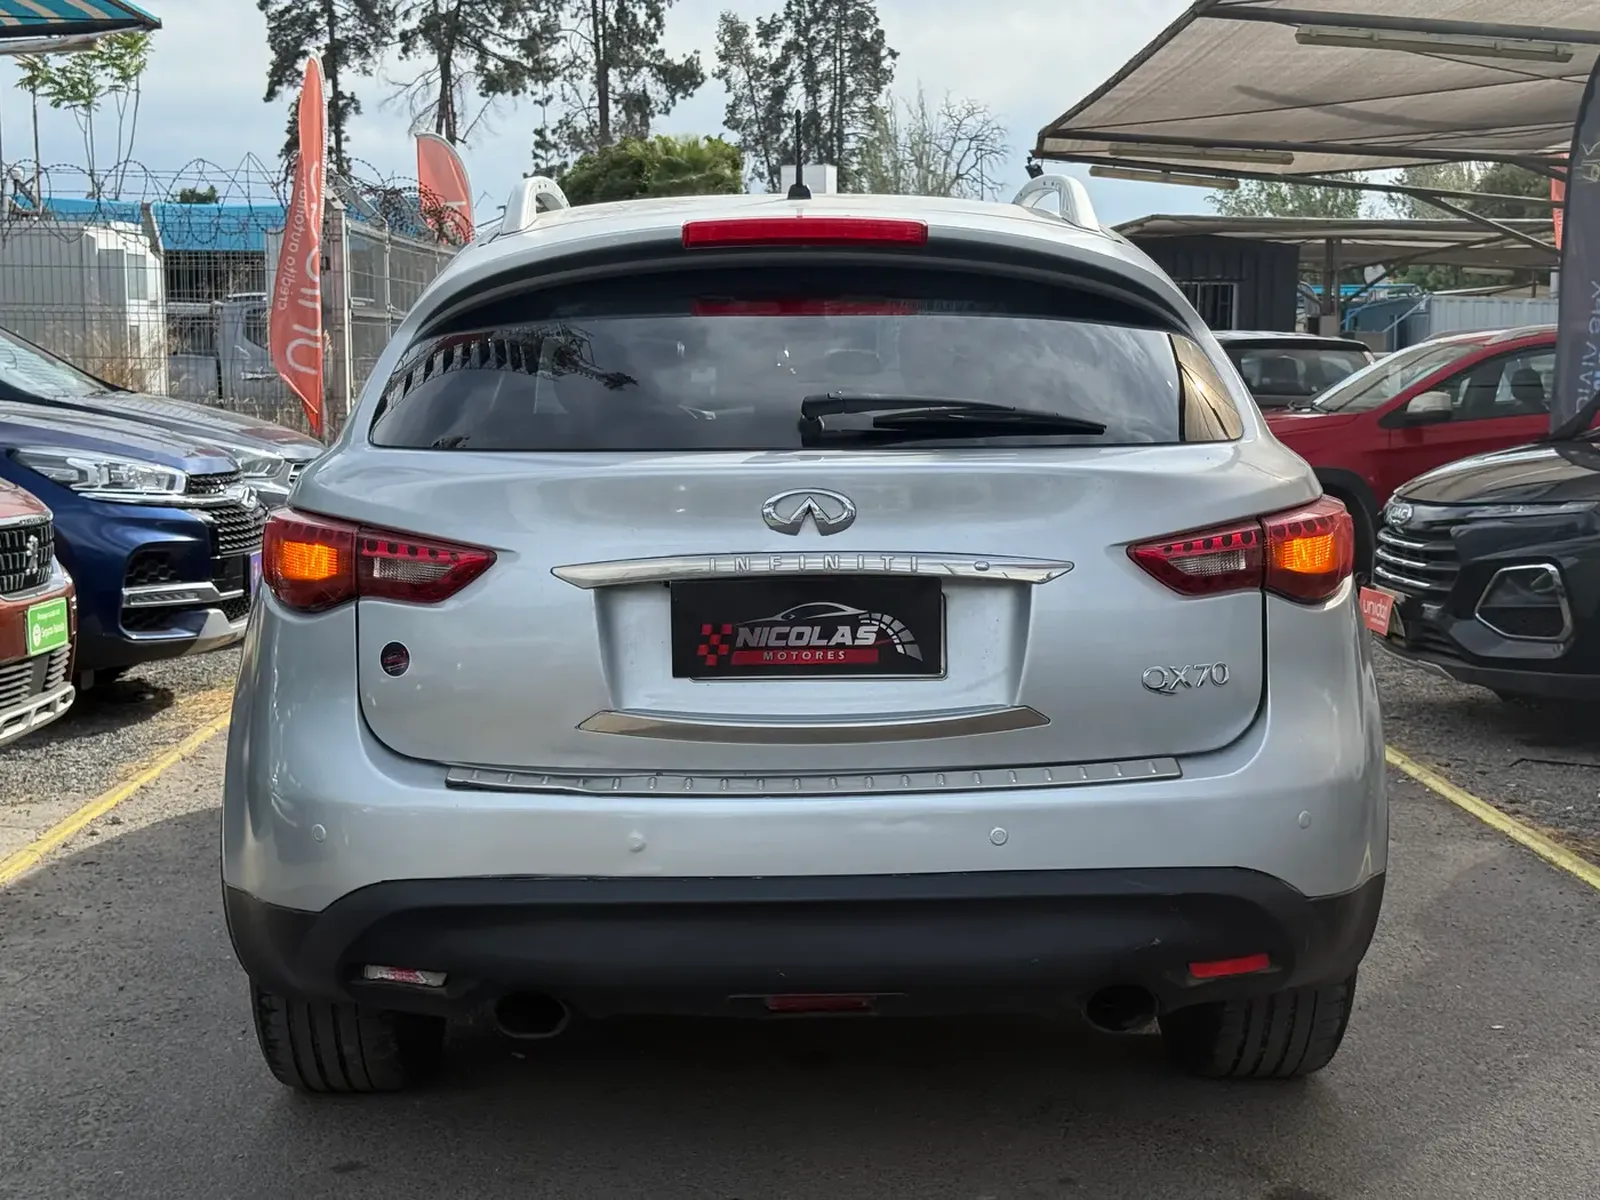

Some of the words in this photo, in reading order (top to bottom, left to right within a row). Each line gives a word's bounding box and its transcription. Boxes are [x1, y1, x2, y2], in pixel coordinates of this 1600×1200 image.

[709, 554, 918, 573] INFINITI
[735, 625, 879, 648] NICOLAS
[763, 650, 845, 661] MOTORES
[1142, 661, 1230, 696] QX70
